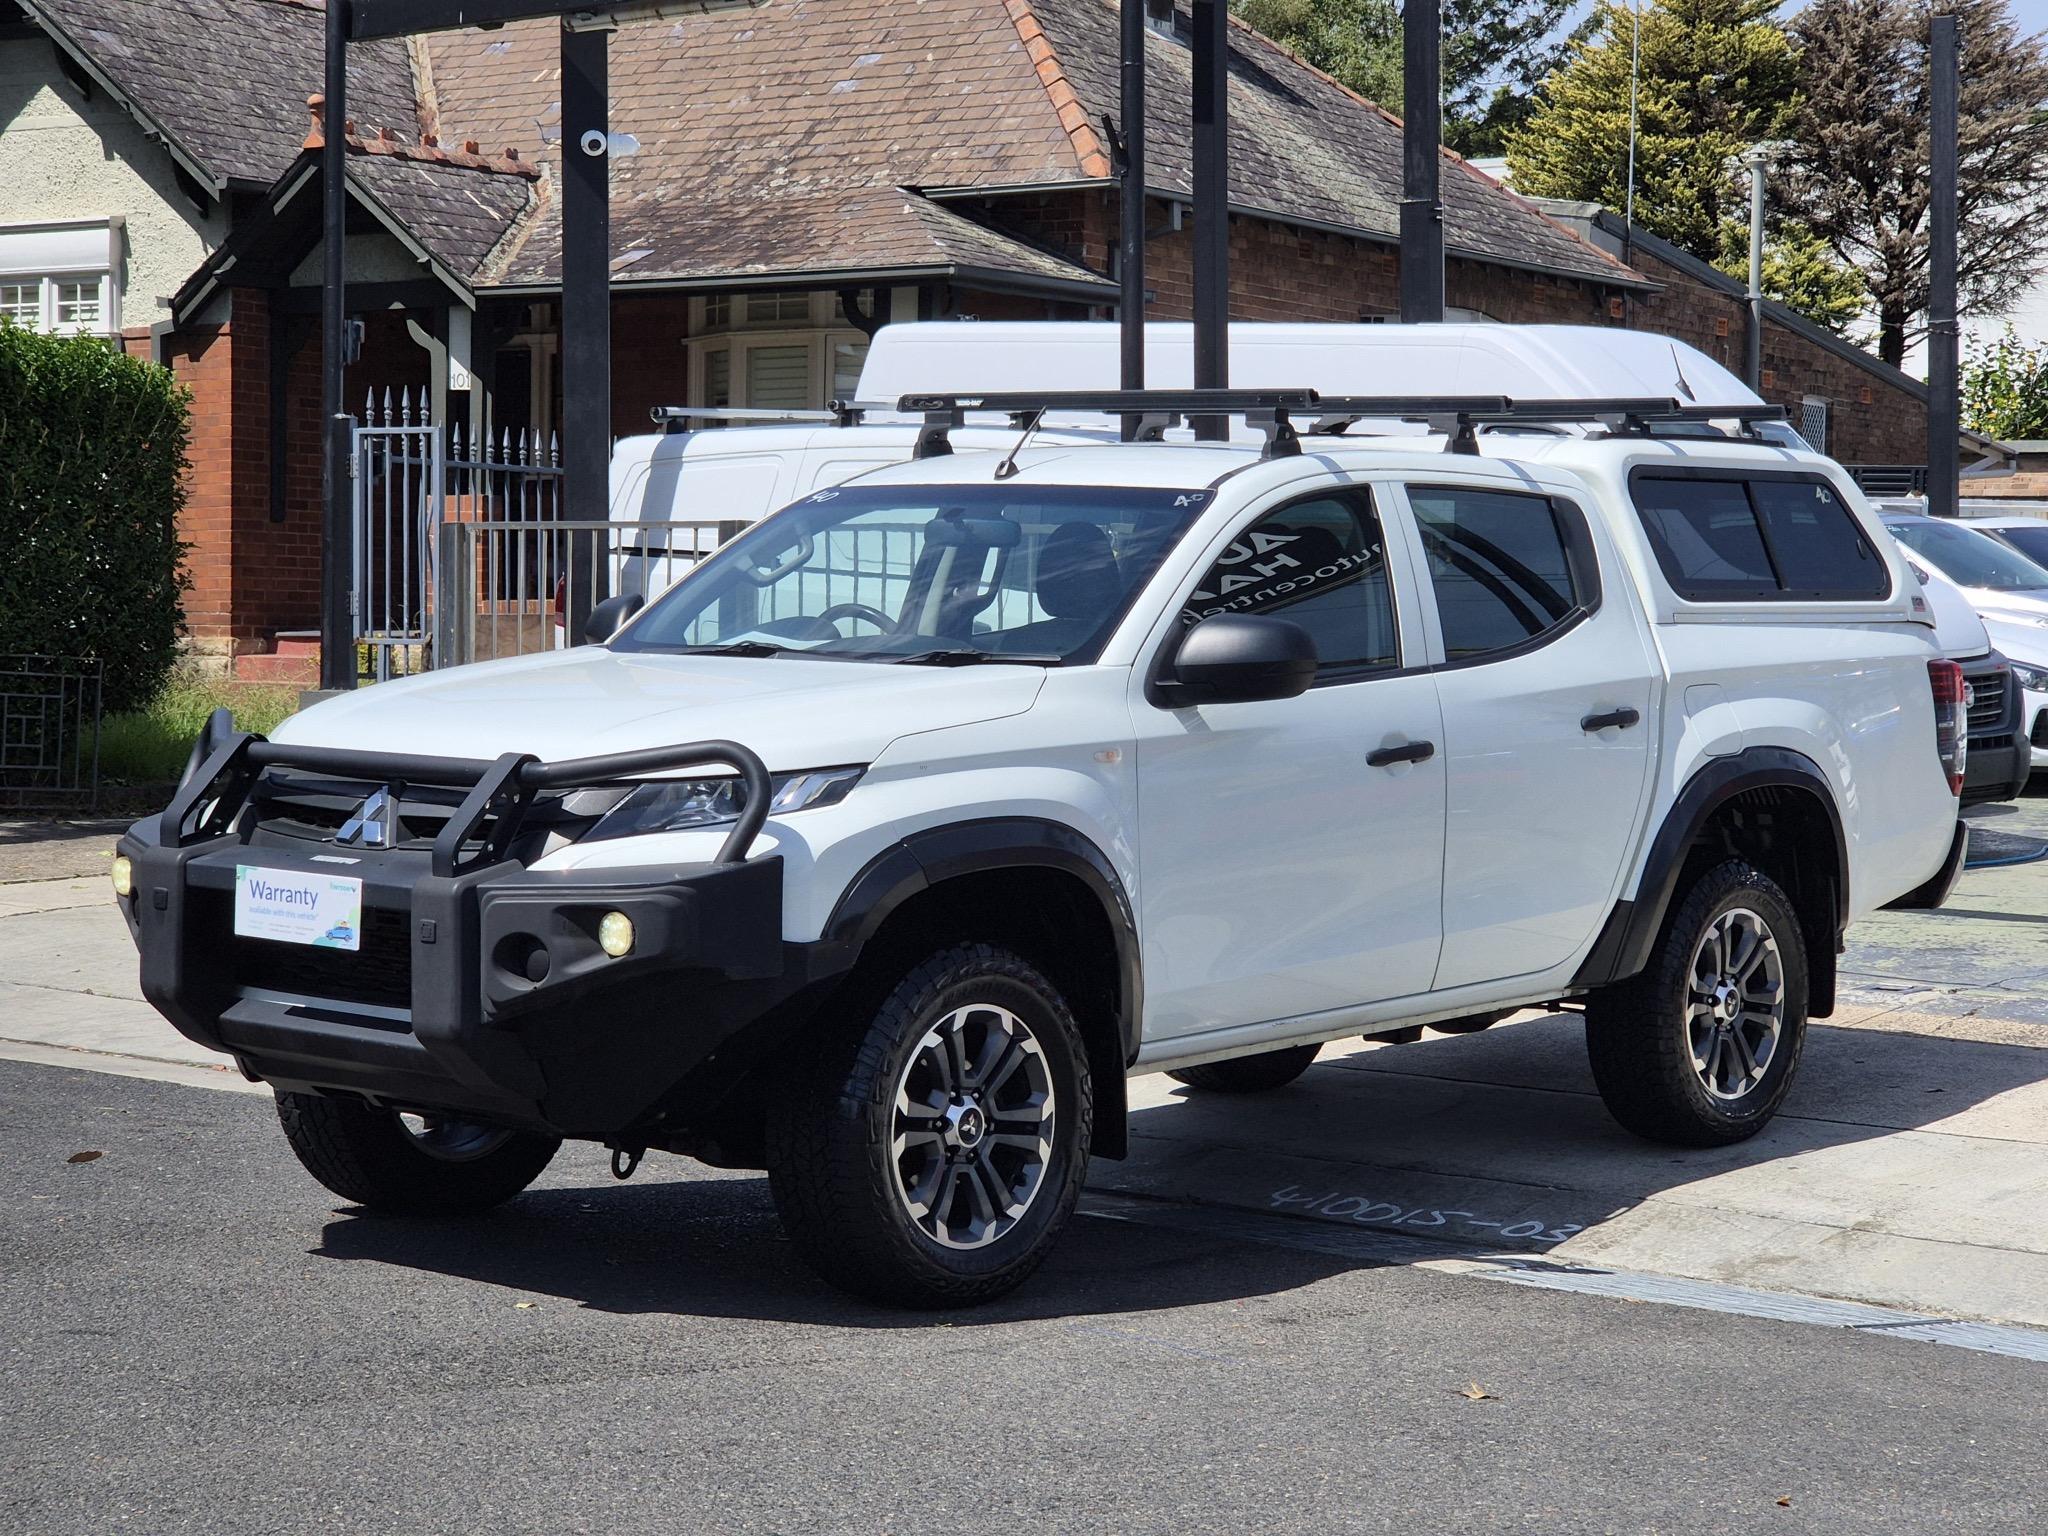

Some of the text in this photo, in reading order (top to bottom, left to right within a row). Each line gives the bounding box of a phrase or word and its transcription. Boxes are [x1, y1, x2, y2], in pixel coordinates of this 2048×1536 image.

[452, 373, 470, 389] 101
[1815, 486, 1831, 504] 40
[249, 879, 319, 910] Warranty
